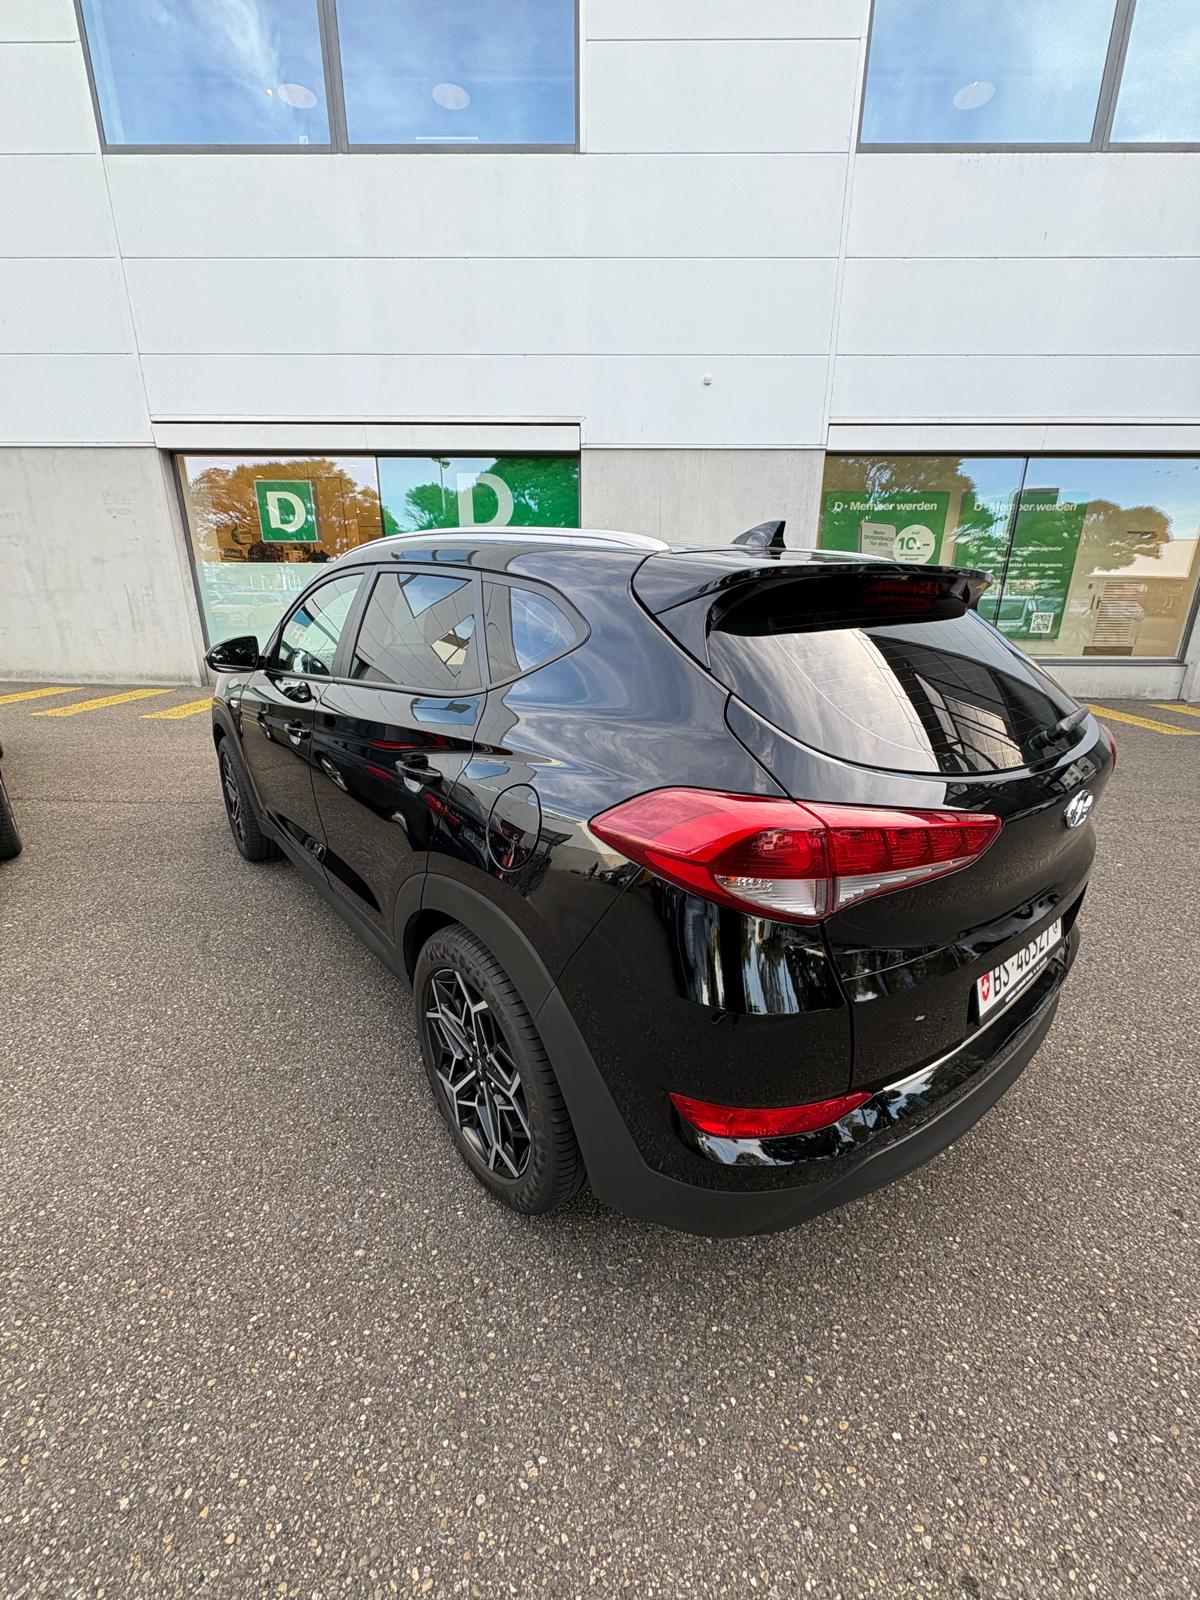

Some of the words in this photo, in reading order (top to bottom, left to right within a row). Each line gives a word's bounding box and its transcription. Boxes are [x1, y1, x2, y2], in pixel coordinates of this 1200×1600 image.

[266, 491, 306, 532] D
[457, 472, 514, 526] D
[850, 501, 895, 511] Member
[896, 501, 938, 511] werden
[1036, 503, 1077, 511] werden
